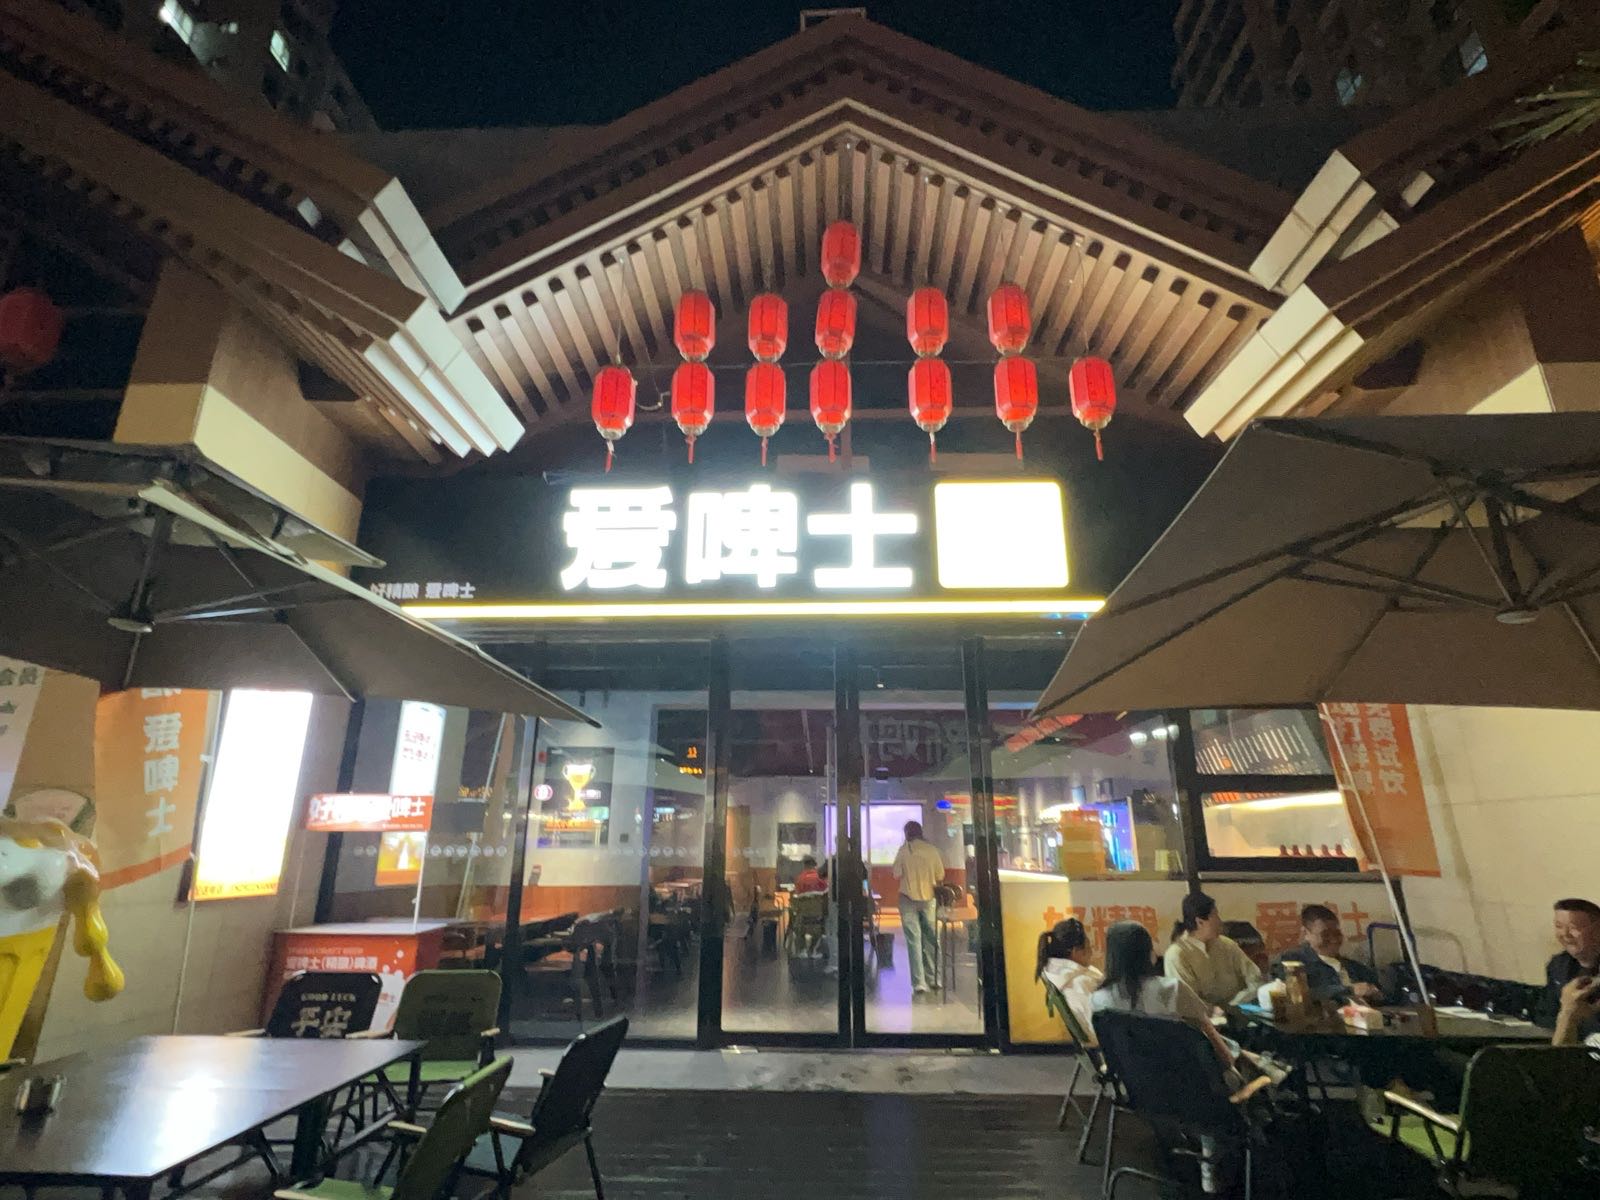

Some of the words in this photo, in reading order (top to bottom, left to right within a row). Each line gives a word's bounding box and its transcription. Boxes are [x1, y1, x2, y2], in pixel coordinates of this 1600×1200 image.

[559, 482, 918, 592] 爱啤士
[142, 712, 183, 837] 爱啤士
[1256, 901, 1369, 956] 爱士
